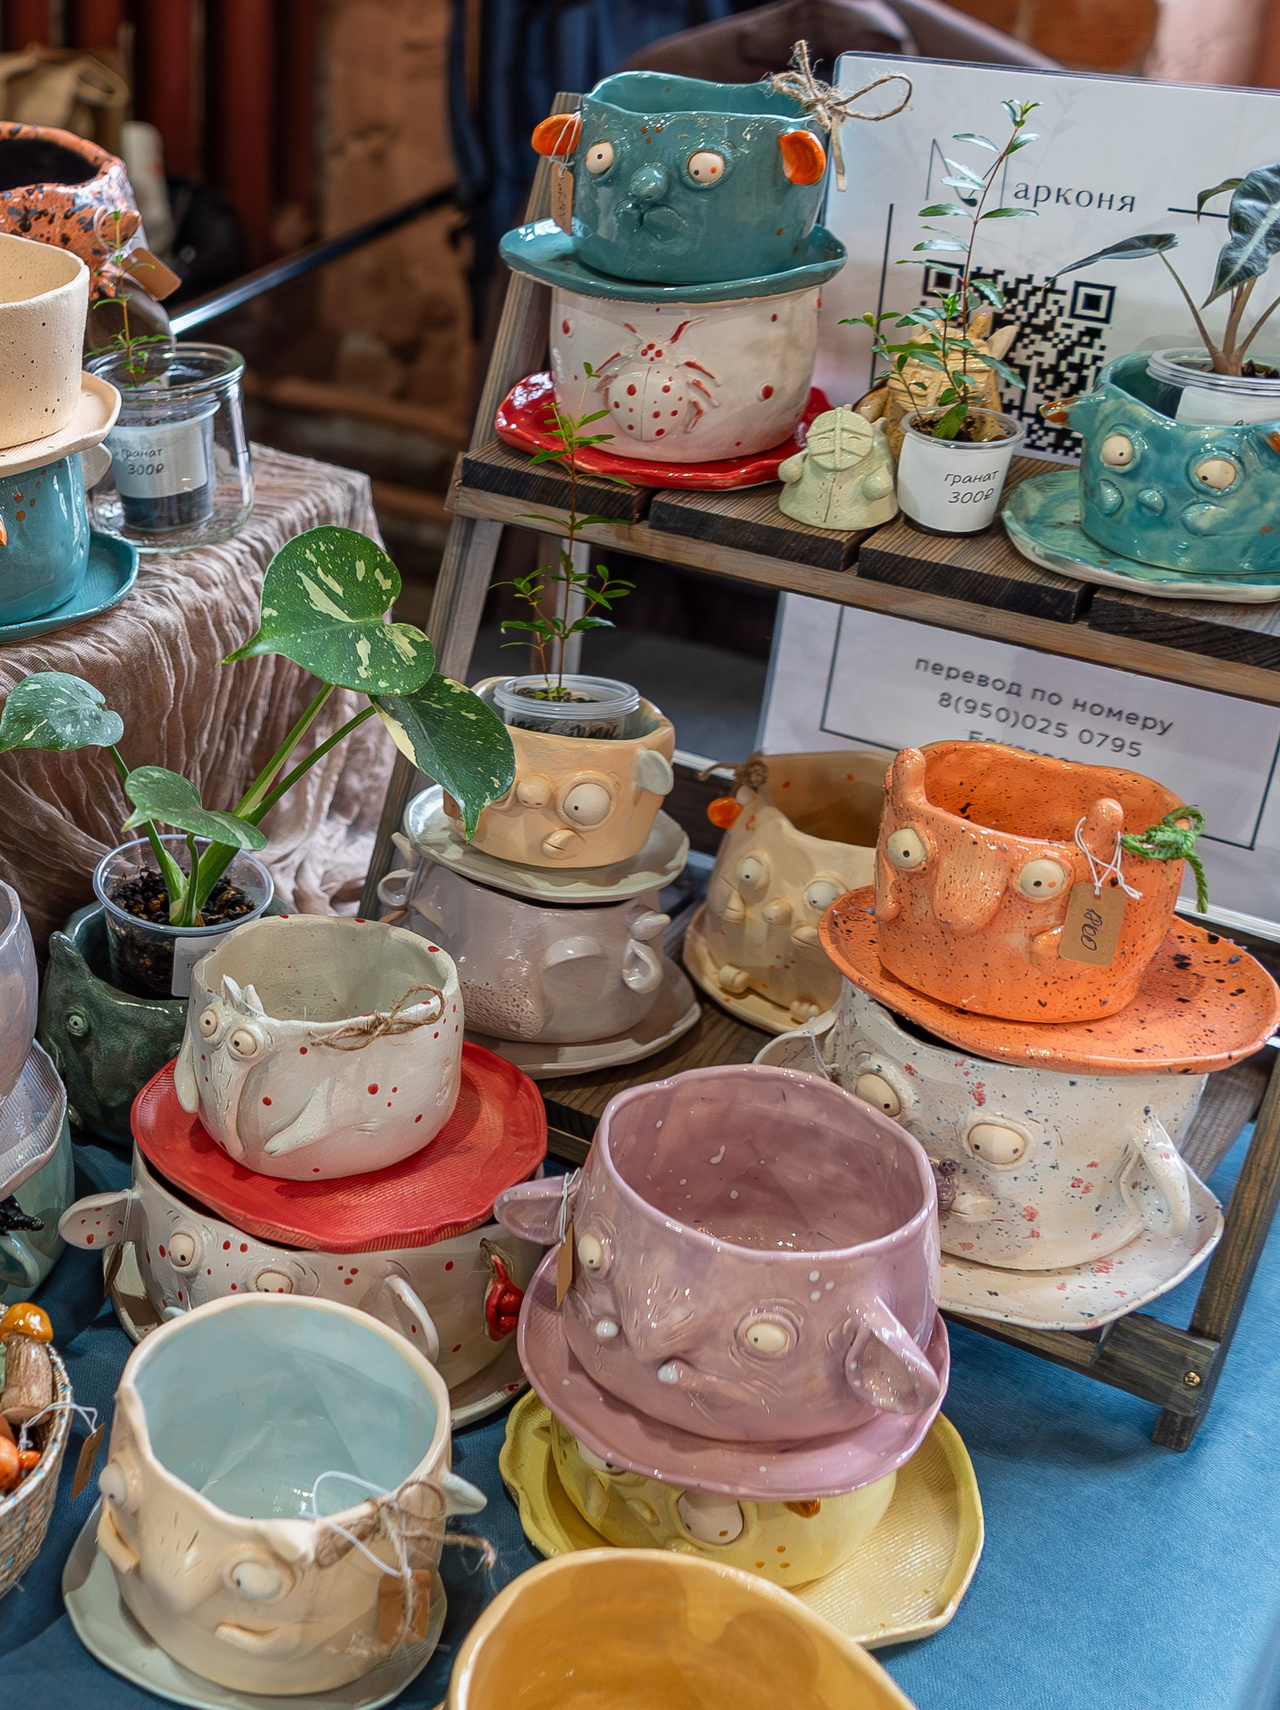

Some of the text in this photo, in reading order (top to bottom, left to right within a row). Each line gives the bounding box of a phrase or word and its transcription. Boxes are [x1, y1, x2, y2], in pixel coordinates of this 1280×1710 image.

[944, 470, 999, 487] гранат
[915, 658, 1174, 736] перевод по номеру
[938, 692, 1068, 739] 8(950)025
[1078, 729, 1143, 758] 0795
